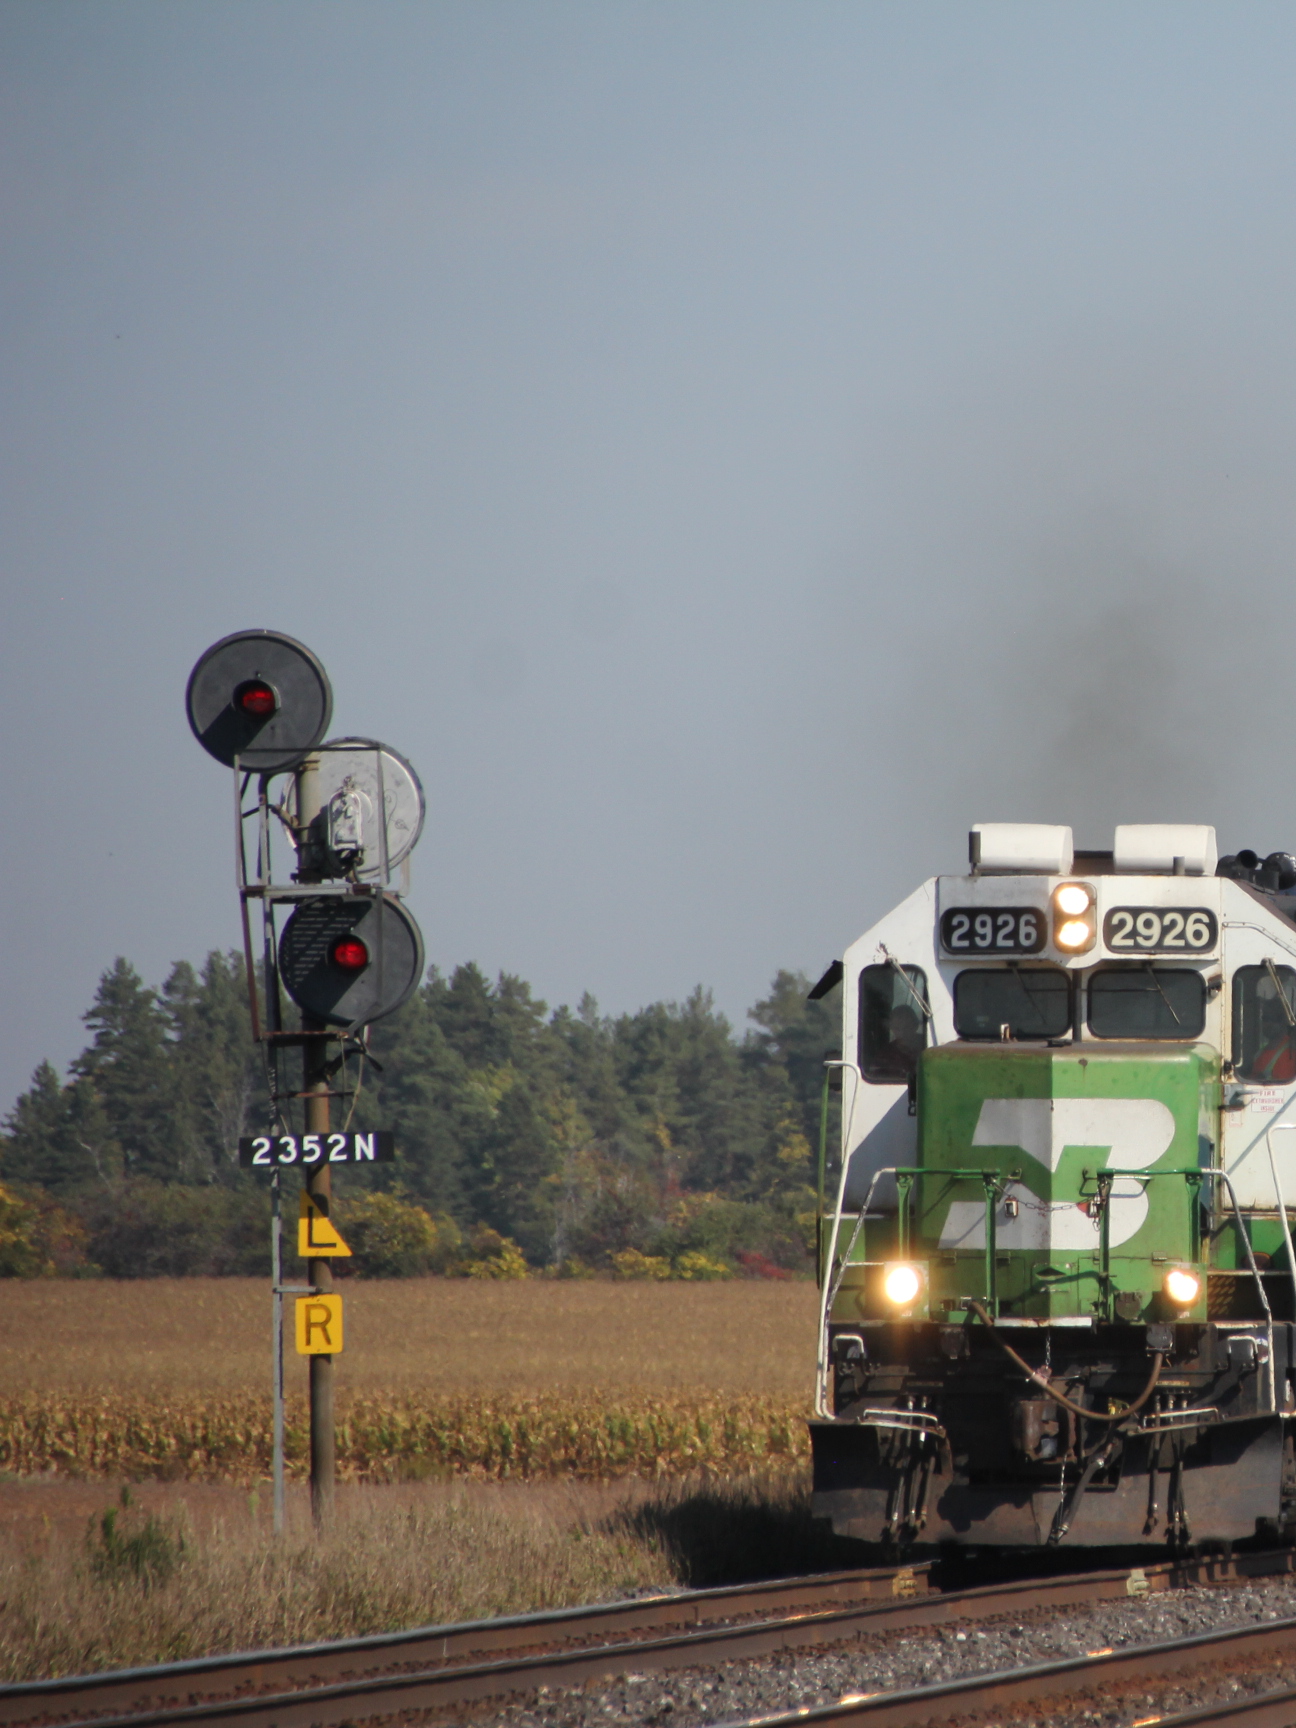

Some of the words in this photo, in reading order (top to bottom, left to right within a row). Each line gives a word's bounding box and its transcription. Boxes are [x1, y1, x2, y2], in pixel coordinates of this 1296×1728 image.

[951, 913, 1038, 947] 2926
[1110, 911, 1210, 947] 2926
[251, 1132, 376, 1165] 2352N
[307, 1205, 338, 1249] L
[304, 1303, 333, 1347] R
